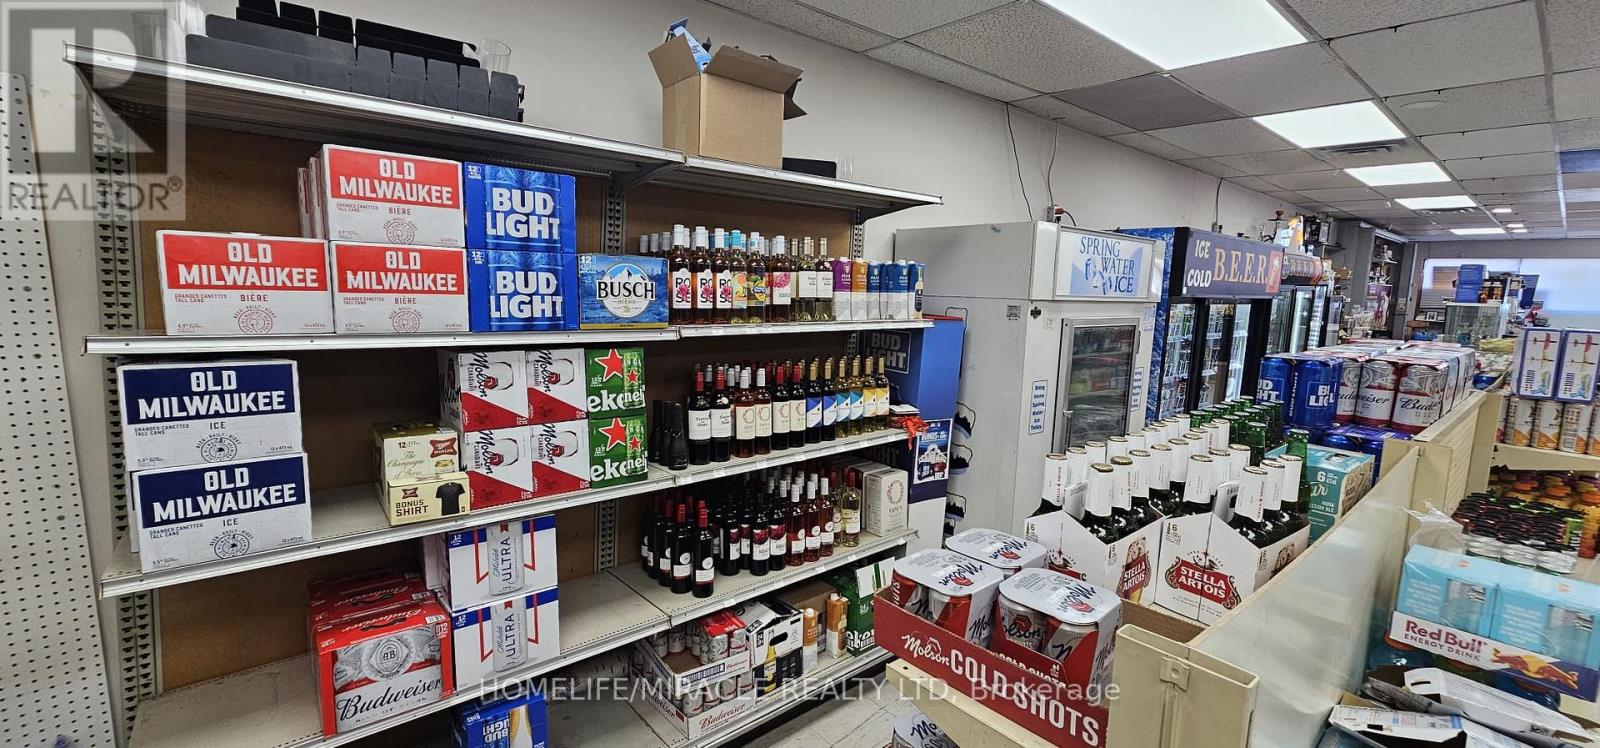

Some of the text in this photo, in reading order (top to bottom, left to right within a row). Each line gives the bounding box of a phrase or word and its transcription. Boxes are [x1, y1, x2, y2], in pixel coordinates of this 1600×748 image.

[379, 158, 415, 180] OLD
[339, 175, 453, 205] MILWAUKEE
[492, 187, 554, 216] BUD
[486, 212, 560, 240] LIGHT
[227, 242, 272, 263] OLD
[1080, 236, 1120, 257] SPRING
[1195, 240, 1211, 258] ICE
[385, 251, 420, 270] OLD
[1101, 257, 1135, 275] WATER
[178, 264, 319, 287] MILWAUKEE
[346, 270, 458, 291] MILWAUKEE
[496, 271, 557, 295] BUD
[1114, 276, 1134, 292] ICE
[1187, 269, 1211, 287] COLD
[598, 281, 654, 299] BUSCH
[490, 295, 563, 318] LIGHT
[871, 333, 901, 349] BUD
[190, 370, 237, 392] OLD
[138, 391, 285, 419] MILWAUKEE
[210, 421, 226, 430] ICE
[475, 431, 495, 474] Molson
[204, 467, 249, 492] OLD
[1317, 471, 1326, 482] 6
[153, 484, 296, 522] MILWAUKEE
[396, 499, 424, 508] BONUS
[396, 505, 429, 517] SHIRT
[176, 523, 203, 531] CANETTES
[223, 518, 239, 527] ICE
[1172, 524, 1177, 532] 6
[501, 537, 512, 582] ULTRA
[1124, 561, 1146, 580] STELLA
[1123, 572, 1146, 591] ARTOIS
[1179, 577, 1226, 599] ARTOIS
[1180, 566, 1226, 590] STELLA
[505, 613, 516, 657] ULTRA
[1406, 620, 1482, 654] Red Bull
[1404, 634, 1481, 661] ENERGY DRINK
[337, 679, 441, 721] Budweiser
[902, 635, 1100, 748] Molson COLD SHOTS
[699, 704, 746, 729] Budweiser
